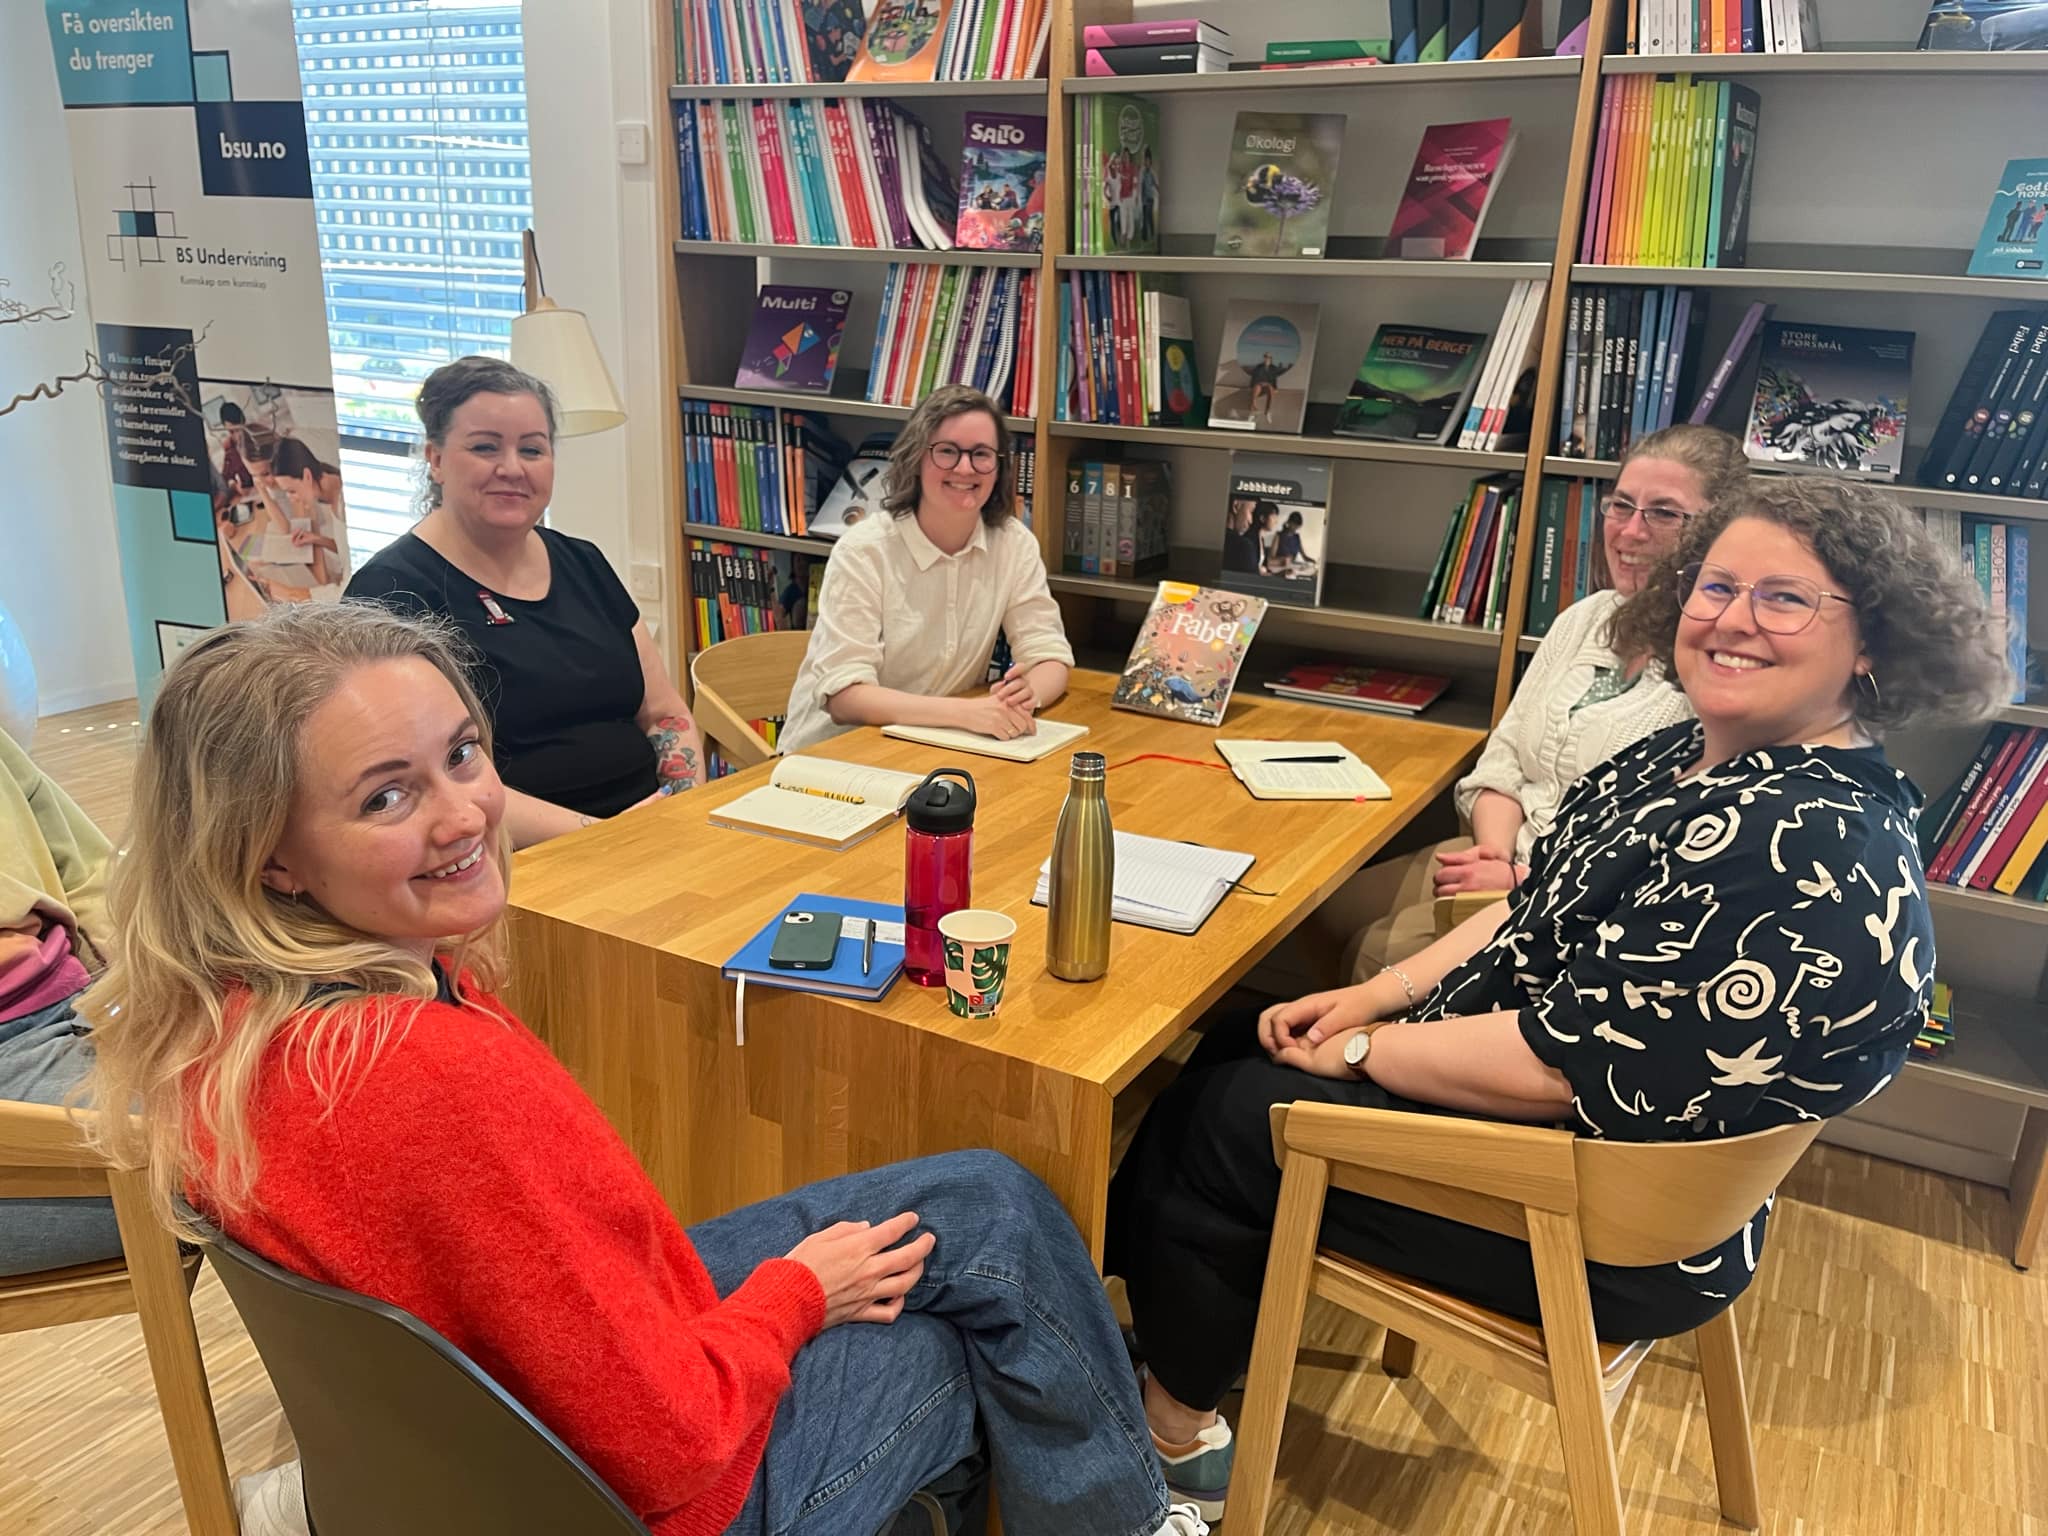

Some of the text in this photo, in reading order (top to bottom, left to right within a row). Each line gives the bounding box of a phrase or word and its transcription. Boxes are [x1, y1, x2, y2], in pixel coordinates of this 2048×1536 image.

[61, 8, 174, 34] Få oversikten
[69, 47, 155, 74] du trenger
[219, 132, 287, 159] bsu.no
[970, 122, 1025, 144] SALTO
[1245, 134, 1297, 155] Økologi
[176, 247, 287, 272] BS Undervisning
[761, 296, 818, 310] Multi
[1781, 330, 1818, 341] STORE
[2008, 325, 2031, 354] Fabel
[1604, 339, 1613, 375] SOLARIS
[1614, 337, 1624, 373] SOLARIS
[1627, 339, 1637, 376] SOLARIS
[1069, 480, 1080, 494] 6
[1088, 481, 1098, 495] 7
[1105, 482, 1116, 496] 8
[1124, 484, 1132, 499] 1
[1236, 480, 1292, 496] Jobbkoder
[1992, 535, 2005, 585] SCOPE
[2013, 536, 2028, 596] SCOPE 2
[1170, 612, 1240, 645] Fabel
